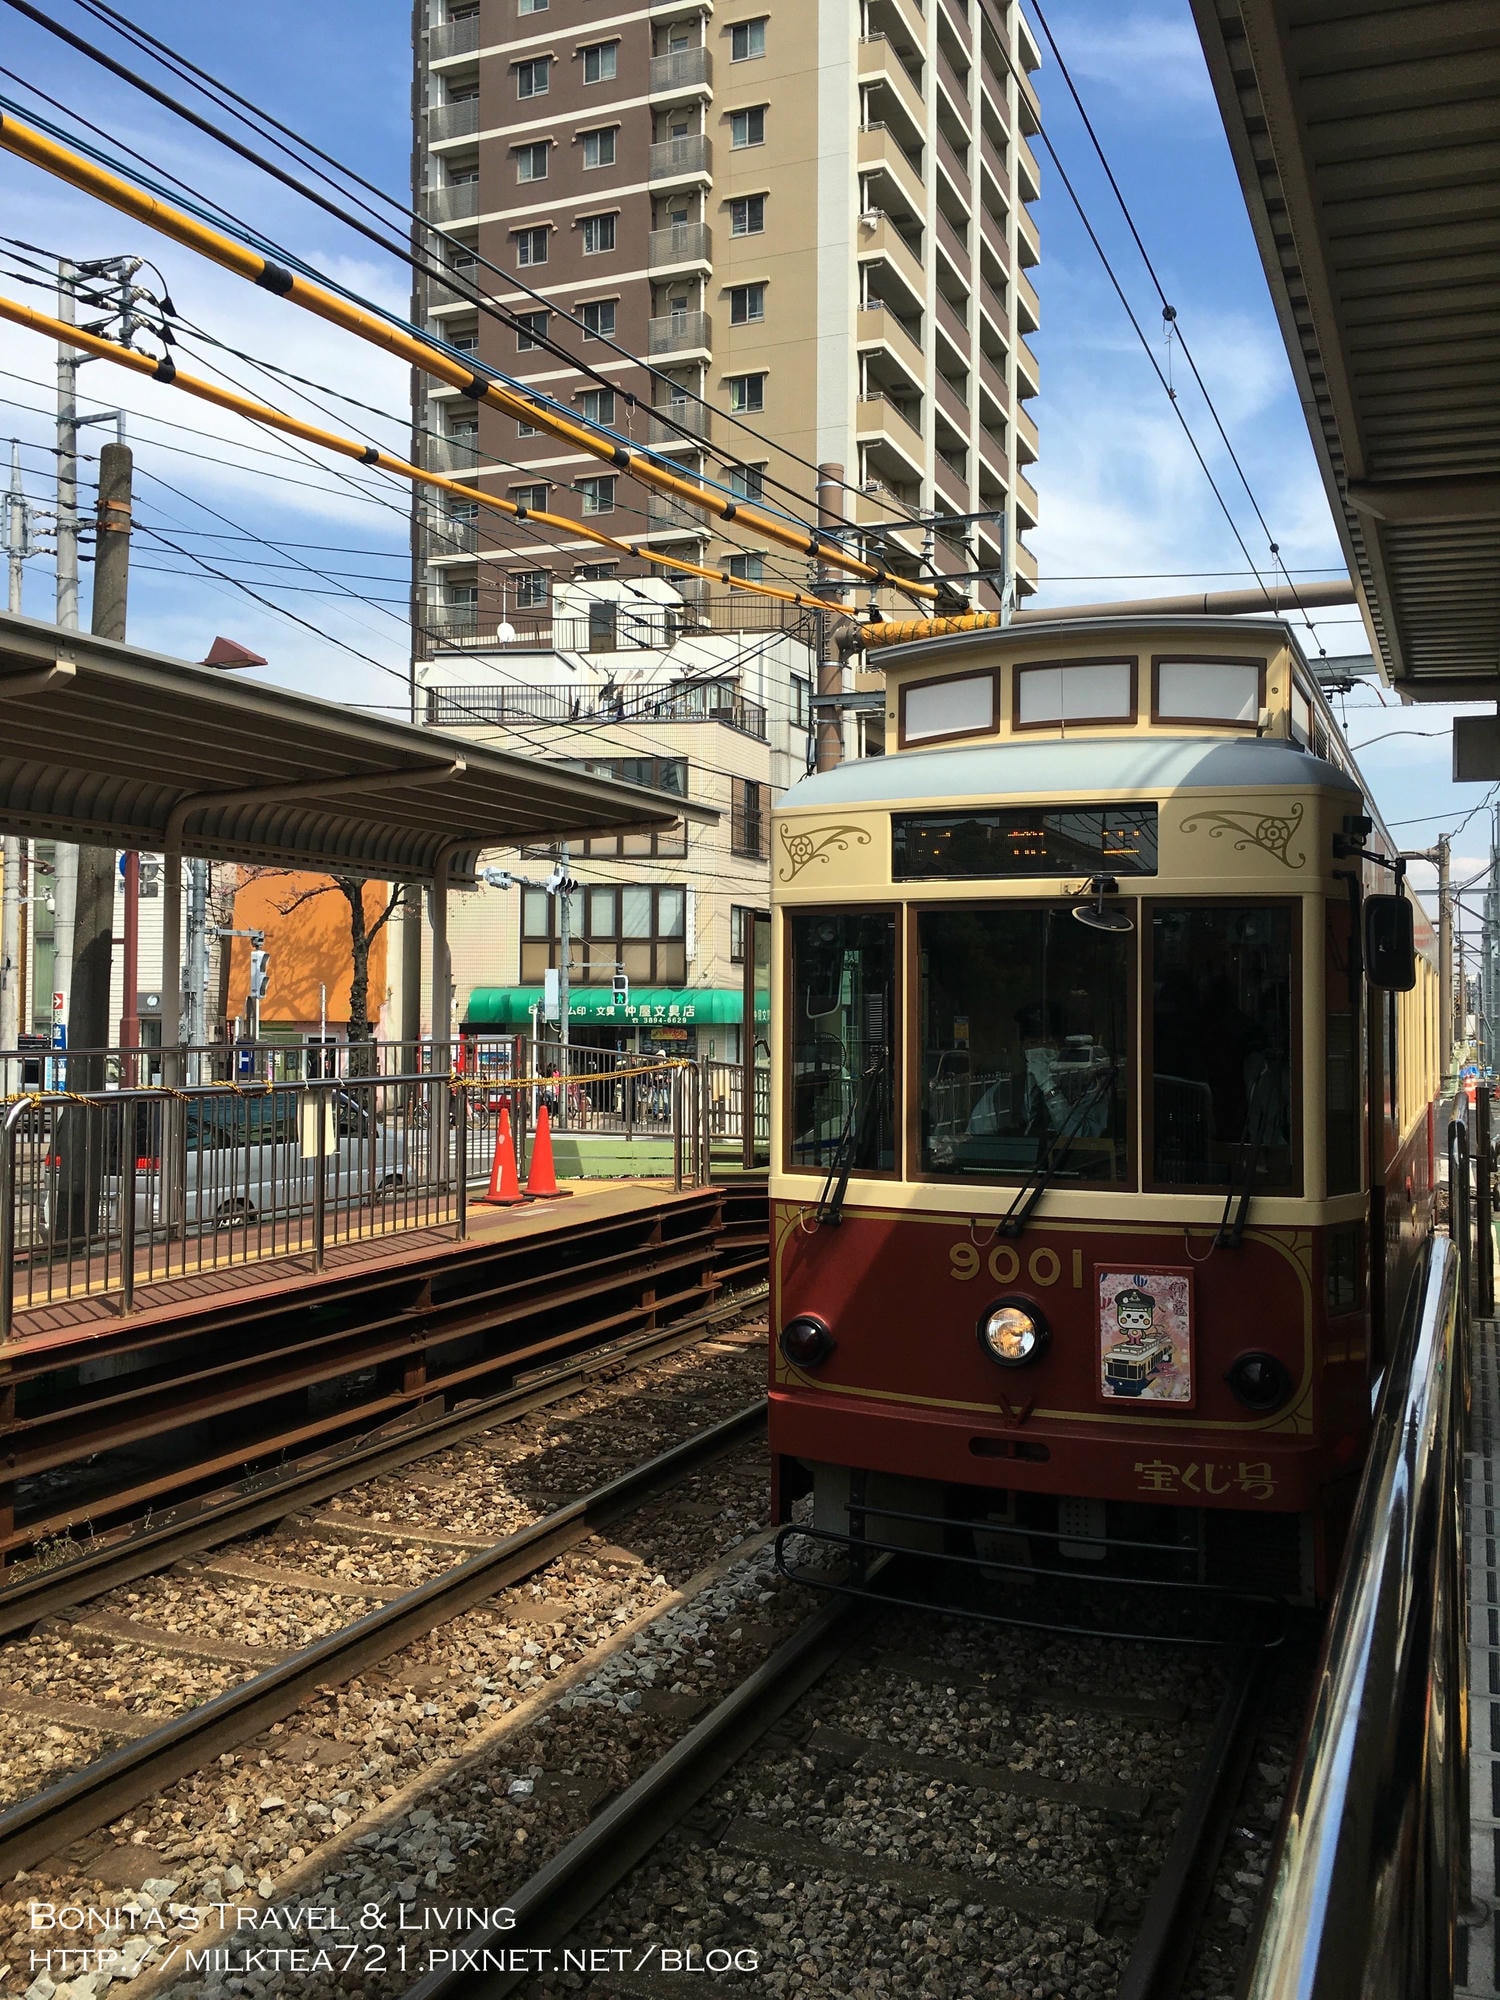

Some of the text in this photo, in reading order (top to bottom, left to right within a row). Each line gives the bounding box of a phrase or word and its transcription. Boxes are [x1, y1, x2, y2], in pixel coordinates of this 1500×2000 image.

[624, 1004, 696, 1018] 仲屋文具店
[949, 1242, 1082, 1288] 9001
[1134, 1459, 1279, 1500] 宝くじ号
